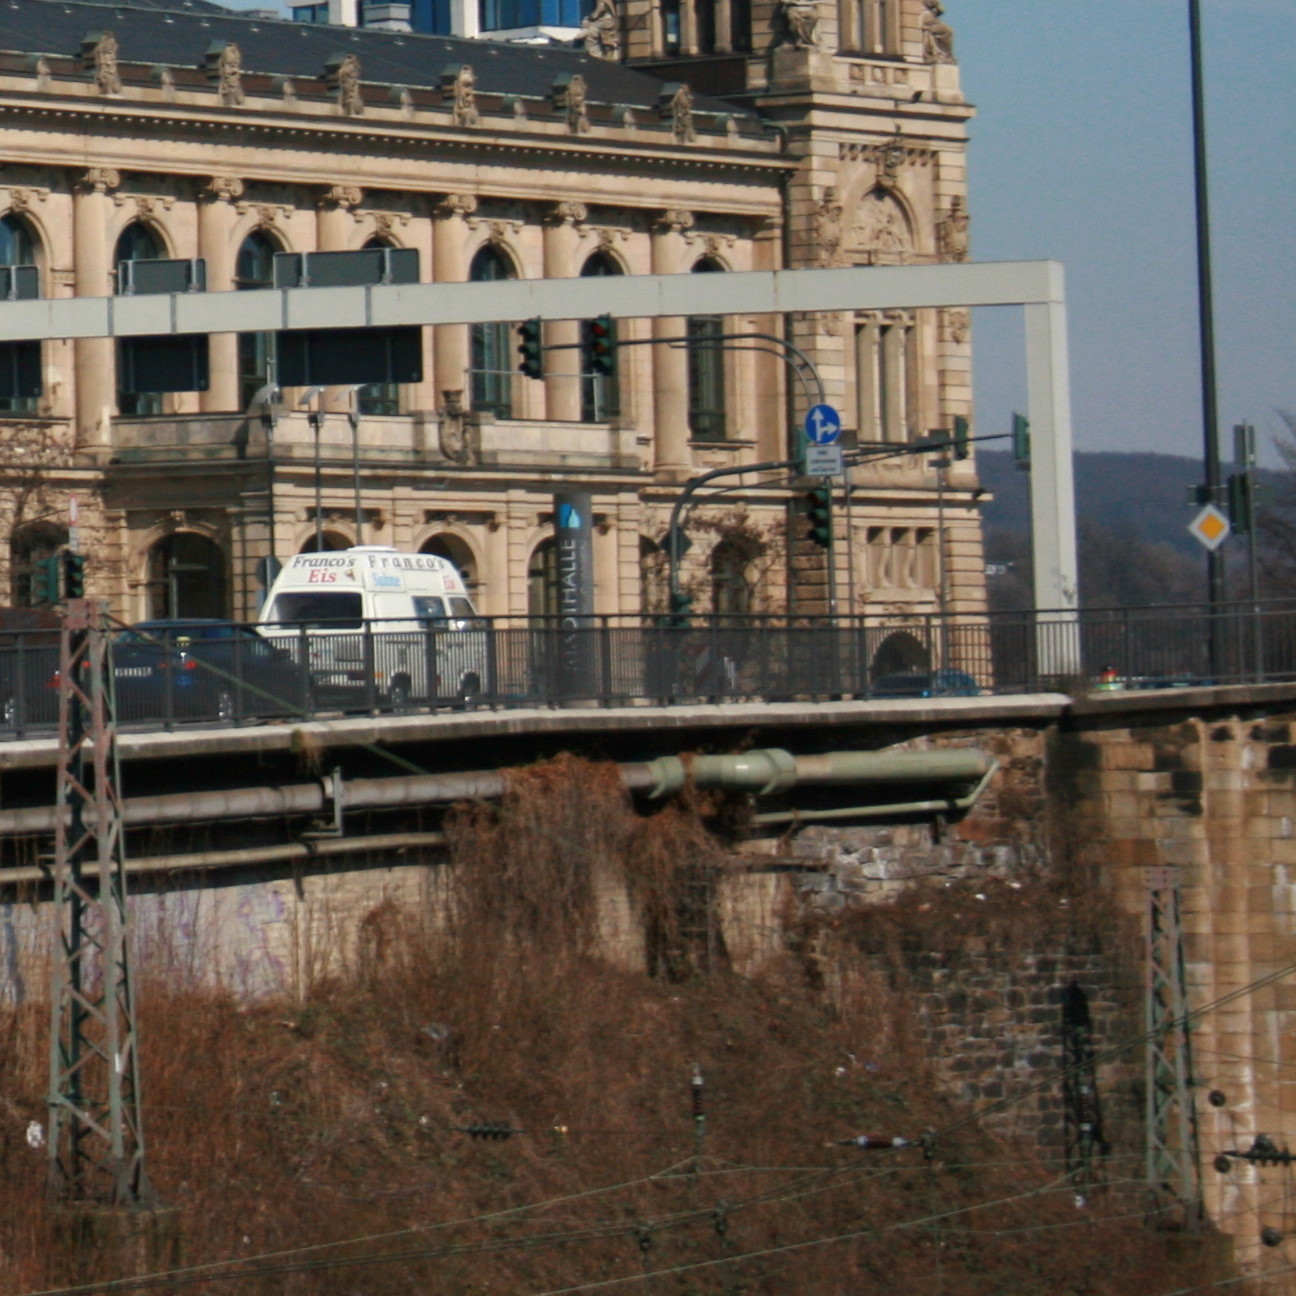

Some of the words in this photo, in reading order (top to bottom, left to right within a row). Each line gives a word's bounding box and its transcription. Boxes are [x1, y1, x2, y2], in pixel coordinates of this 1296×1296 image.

[292, 555, 357, 568] Franco's
[368, 555, 445, 569] Franco's
[307, 568, 337, 583] Eis
